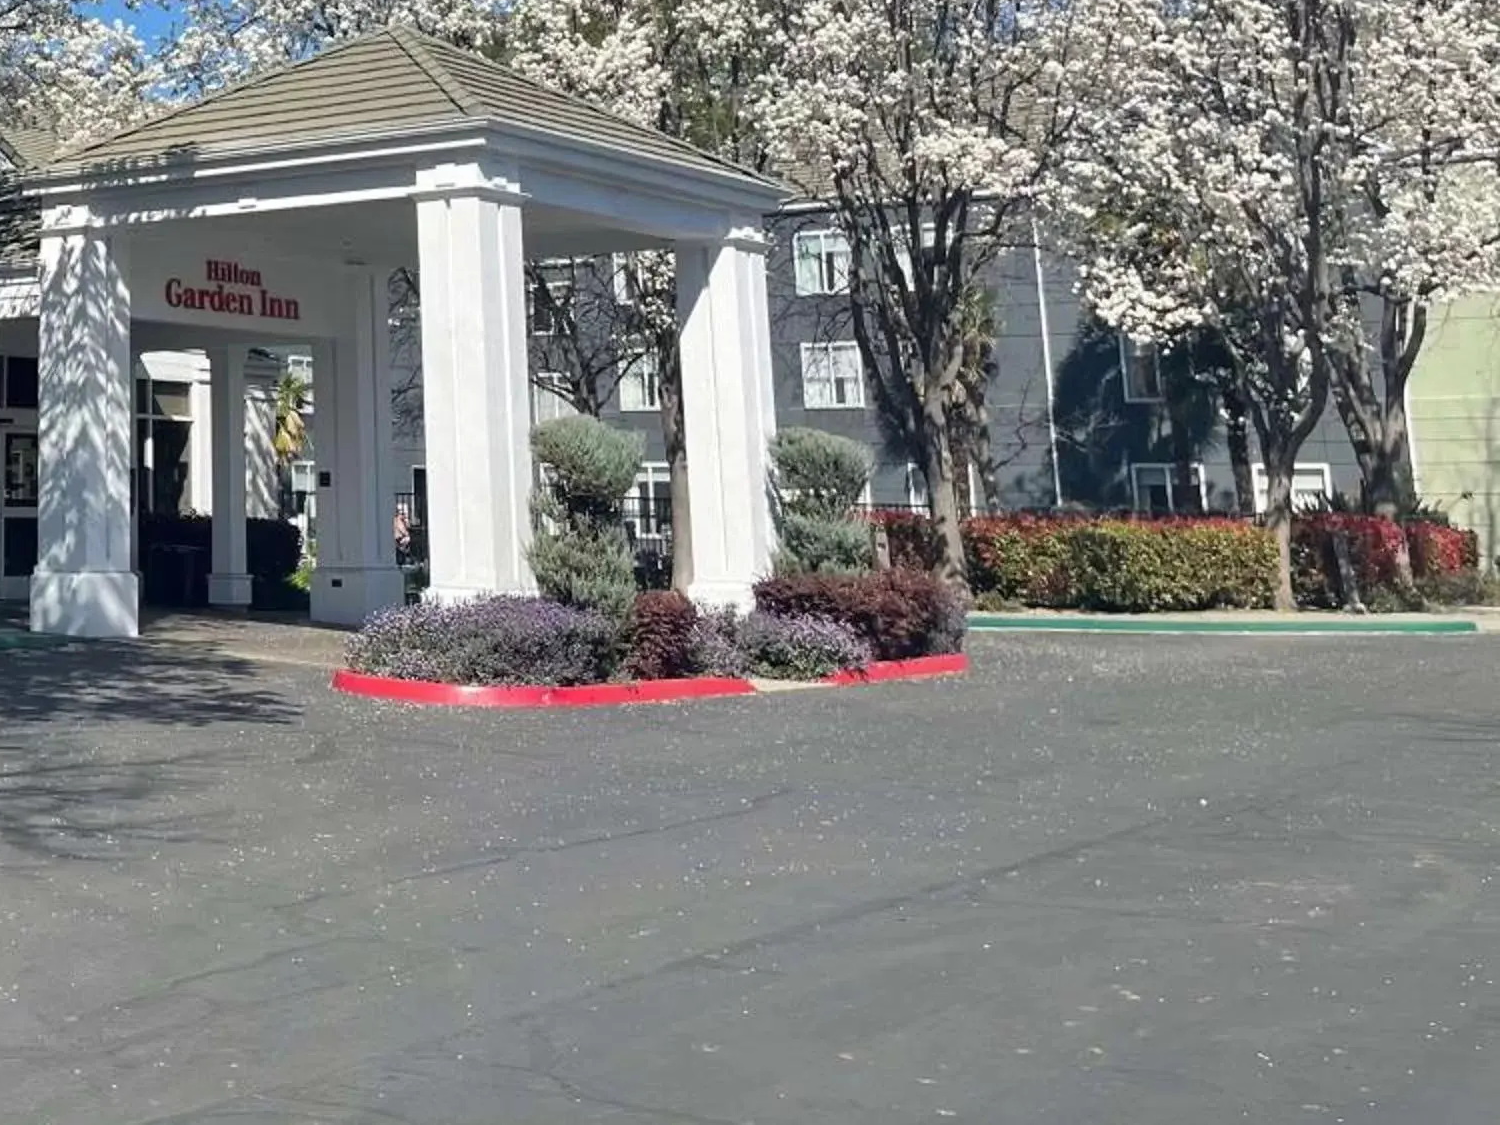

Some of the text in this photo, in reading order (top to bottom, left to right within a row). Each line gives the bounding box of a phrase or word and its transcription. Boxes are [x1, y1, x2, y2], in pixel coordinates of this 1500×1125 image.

[206, 260, 261, 286] Hilton
[165, 278, 299, 320] Garden Inn
